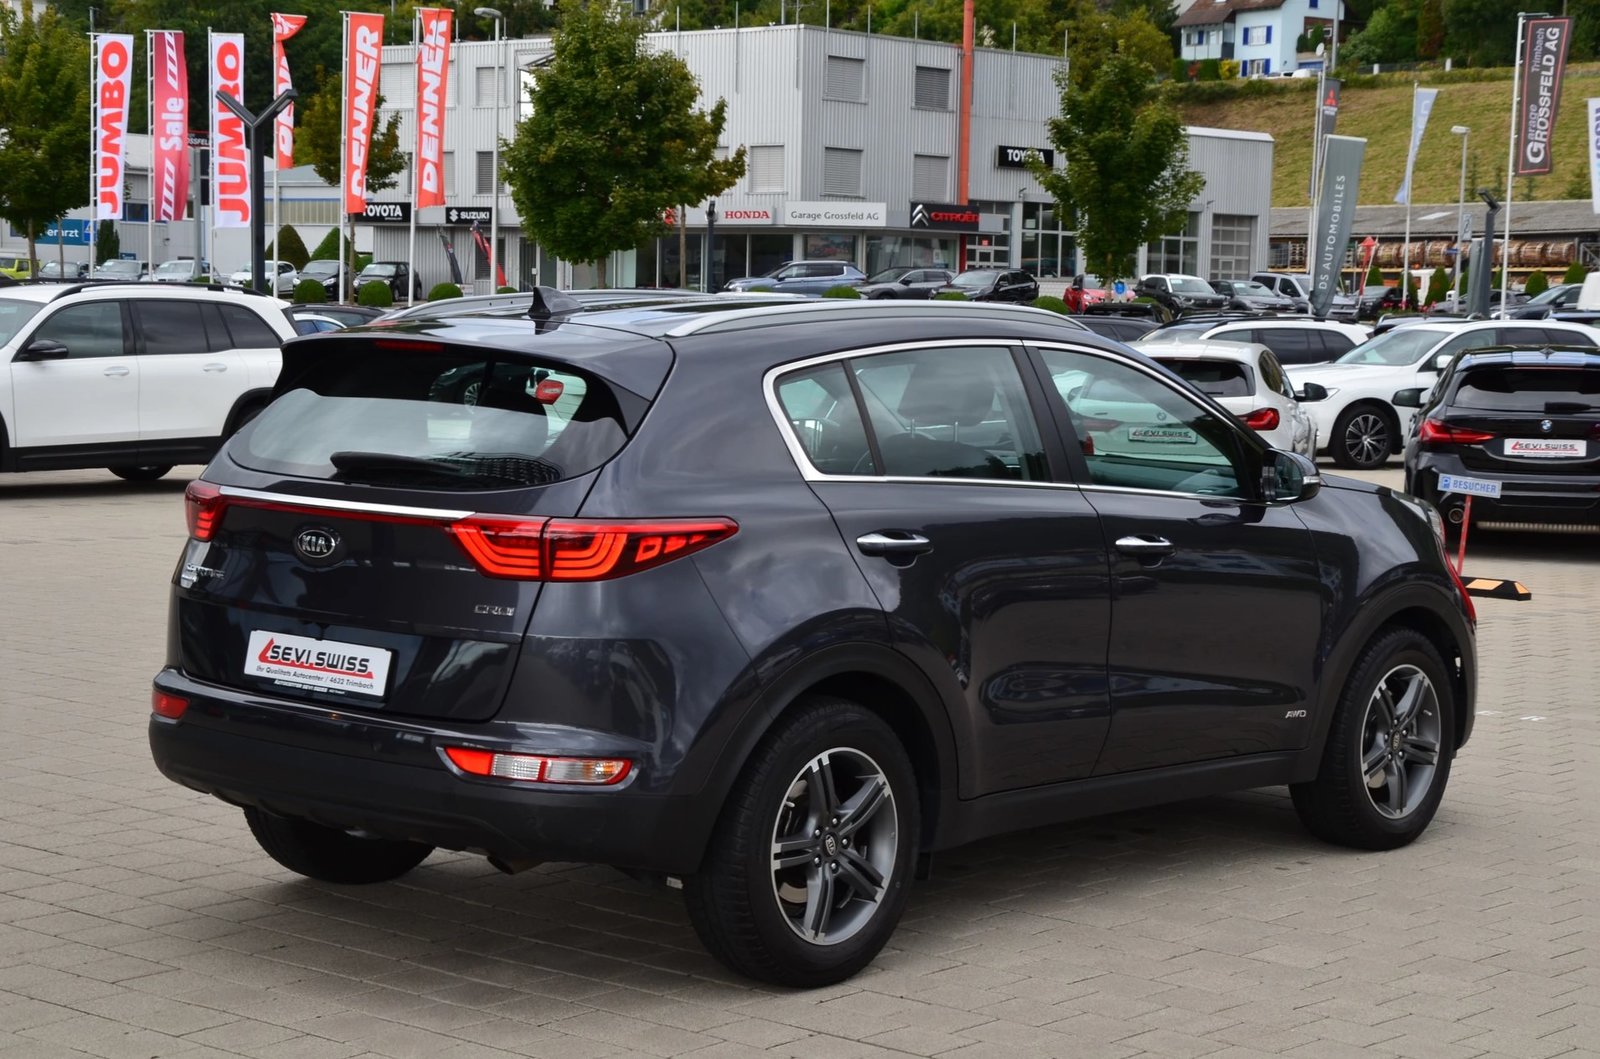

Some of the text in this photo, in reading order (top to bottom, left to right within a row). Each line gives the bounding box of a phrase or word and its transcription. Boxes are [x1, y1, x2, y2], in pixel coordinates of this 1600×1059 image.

[1531, 27, 1545, 72] Trimbach
[1544, 27, 1560, 51] AG
[351, 25, 379, 199] DENNER
[421, 19, 448, 193] DENNER
[100, 41, 128, 214] JUMBO
[160, 97, 184, 151] Sale
[1007, 149, 1045, 163] TOYA
[460, 211, 490, 219] SUZUKI
[725, 210, 770, 219] HONDA
[791, 211, 879, 221] Garage Grossfeld AG
[1319, 175, 1346, 290] DS AUTOMOBILES
[1453, 480, 1496, 493] BESUCHER
[303, 535, 327, 552] KIA
[269, 644, 370, 673] SEVI SWISS
[292, 671, 323, 681] Autocenter
[346, 679, 374, 690] Trimbach
[1285, 710, 1306, 718] AWD
